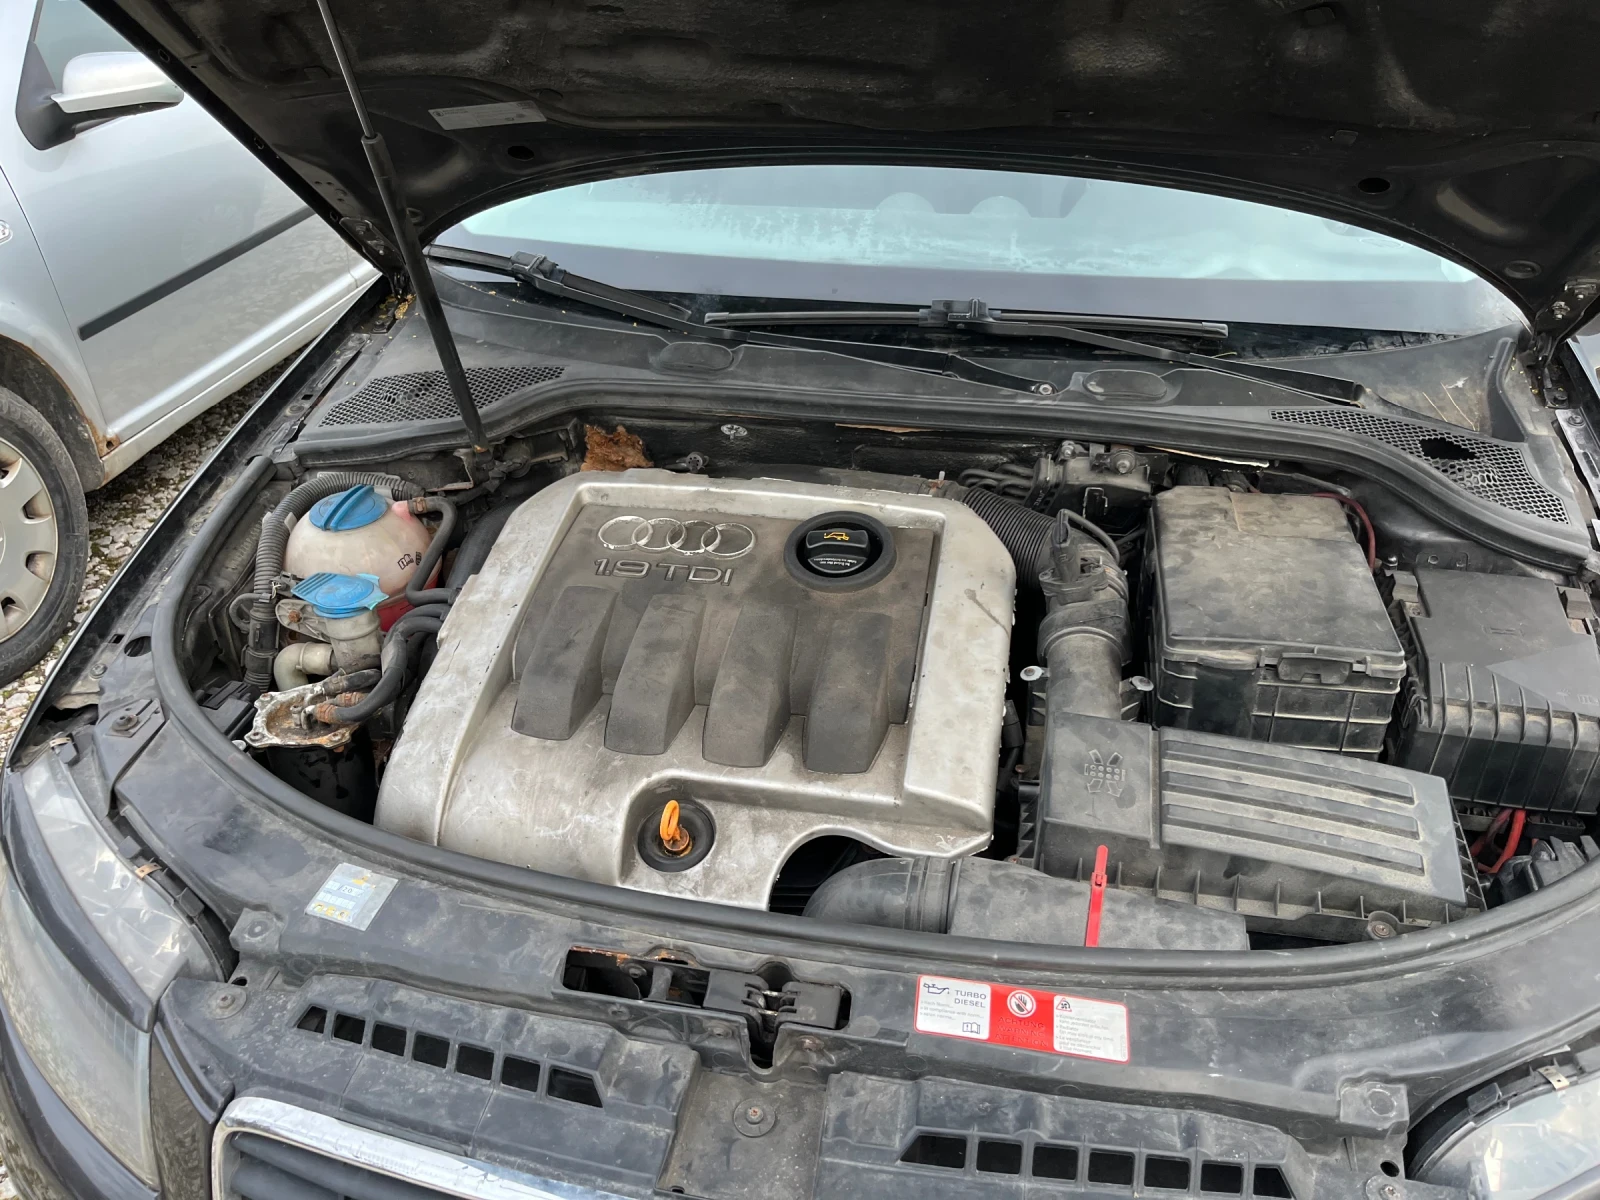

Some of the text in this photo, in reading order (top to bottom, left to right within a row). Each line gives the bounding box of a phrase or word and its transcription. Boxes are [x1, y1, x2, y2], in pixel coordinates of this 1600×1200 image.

[594, 558, 734, 587] 1.9 TDI
[954, 989, 987, 1000] TURBO
[954, 998, 986, 1008] DIESEL
[998, 1016, 1045, 1029] ACHTUNG
